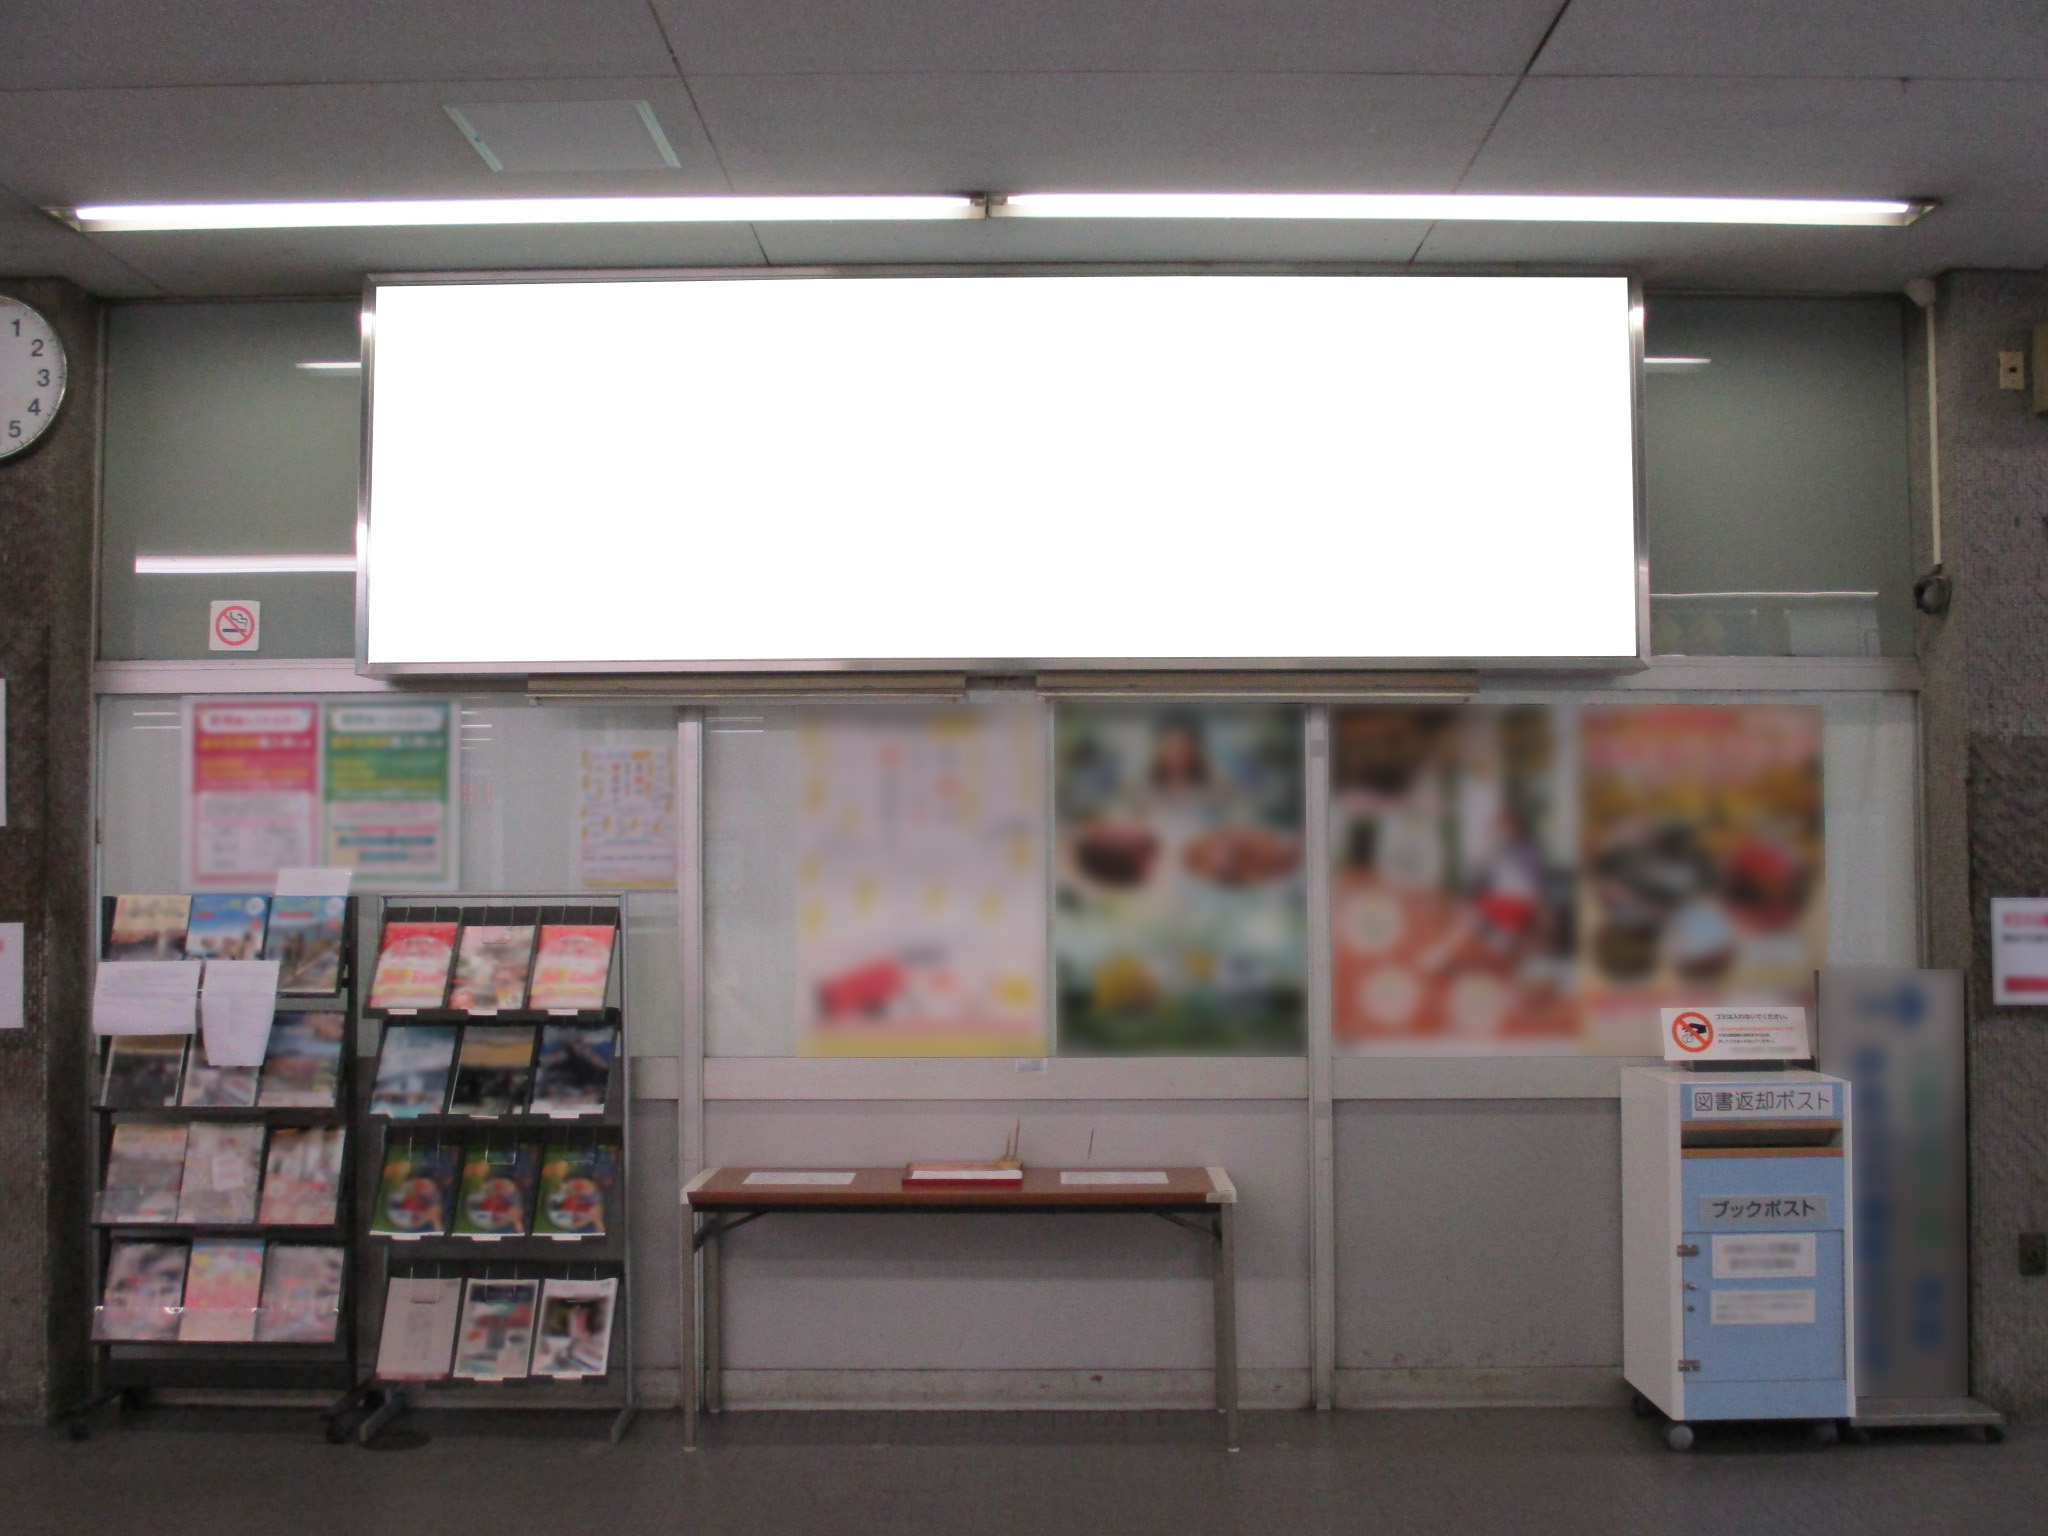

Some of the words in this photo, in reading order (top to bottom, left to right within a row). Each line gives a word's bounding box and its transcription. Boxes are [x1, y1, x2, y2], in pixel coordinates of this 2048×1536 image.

[11, 319, 20, 337] 1
[31, 339, 44, 357] 2
[37, 369, 50, 387] 3
[27, 398, 41, 416] 4
[8, 420, 21, 438] 5
[1694, 1090, 1830, 1112] 図書返却ポスト
[1713, 1199, 1815, 1219] ブックポスト
